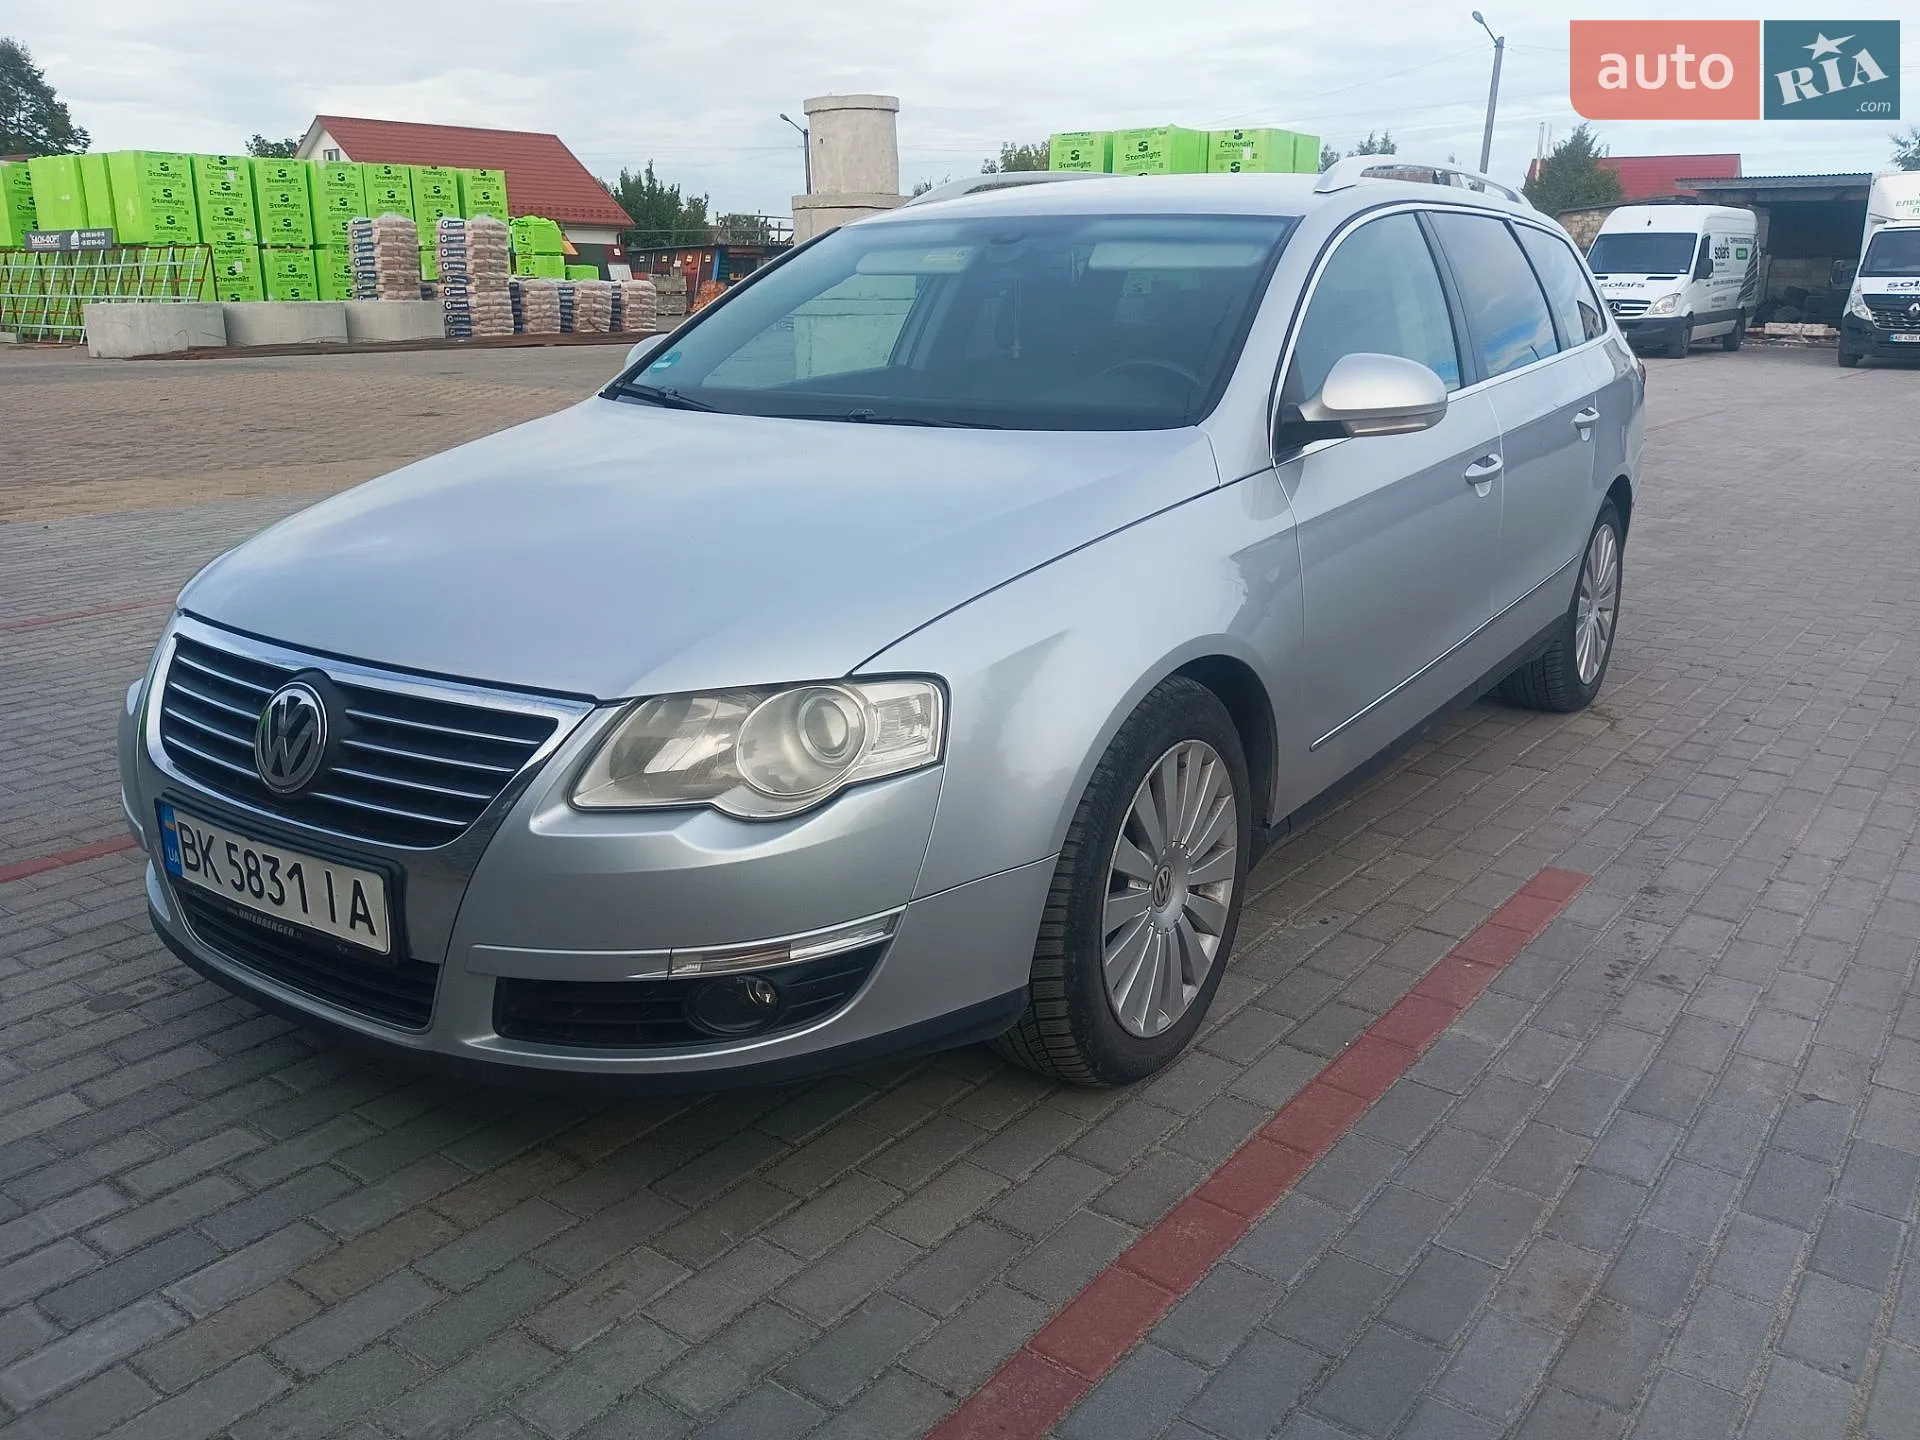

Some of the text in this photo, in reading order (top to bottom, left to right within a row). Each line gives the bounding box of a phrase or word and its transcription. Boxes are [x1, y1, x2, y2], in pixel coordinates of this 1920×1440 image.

[1124, 151, 1161, 162] Stonelight
[1058, 161, 1091, 169] Stonelight
[167, 846, 180, 864] UA
[177, 821, 377, 936] BK 5831 IA
